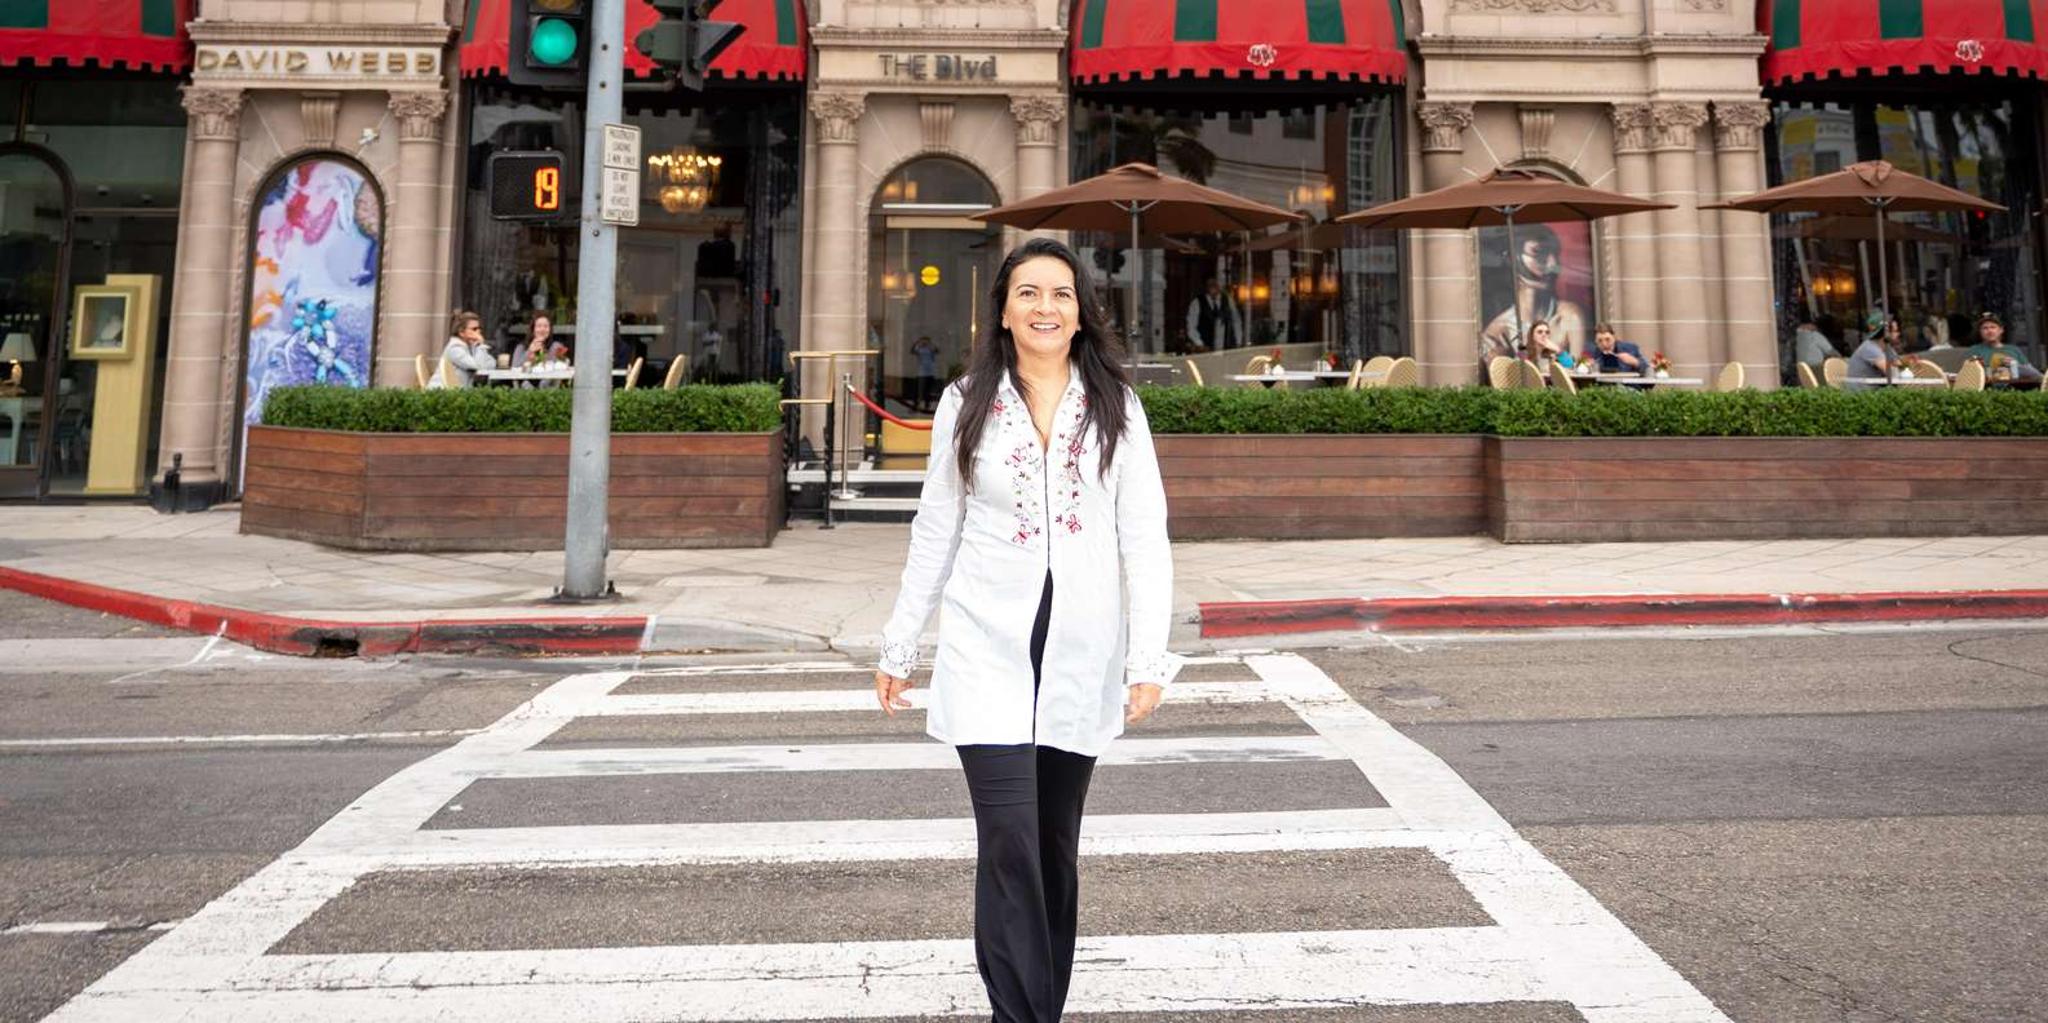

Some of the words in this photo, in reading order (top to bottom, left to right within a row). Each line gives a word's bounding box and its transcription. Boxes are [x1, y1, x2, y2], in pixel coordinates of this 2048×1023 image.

[197, 49, 309, 72] DAVID
[327, 50, 436, 74] WEBB
[878, 54, 928, 80] THE
[934, 54, 998, 80] Blvd
[534, 166, 560, 211] 19
